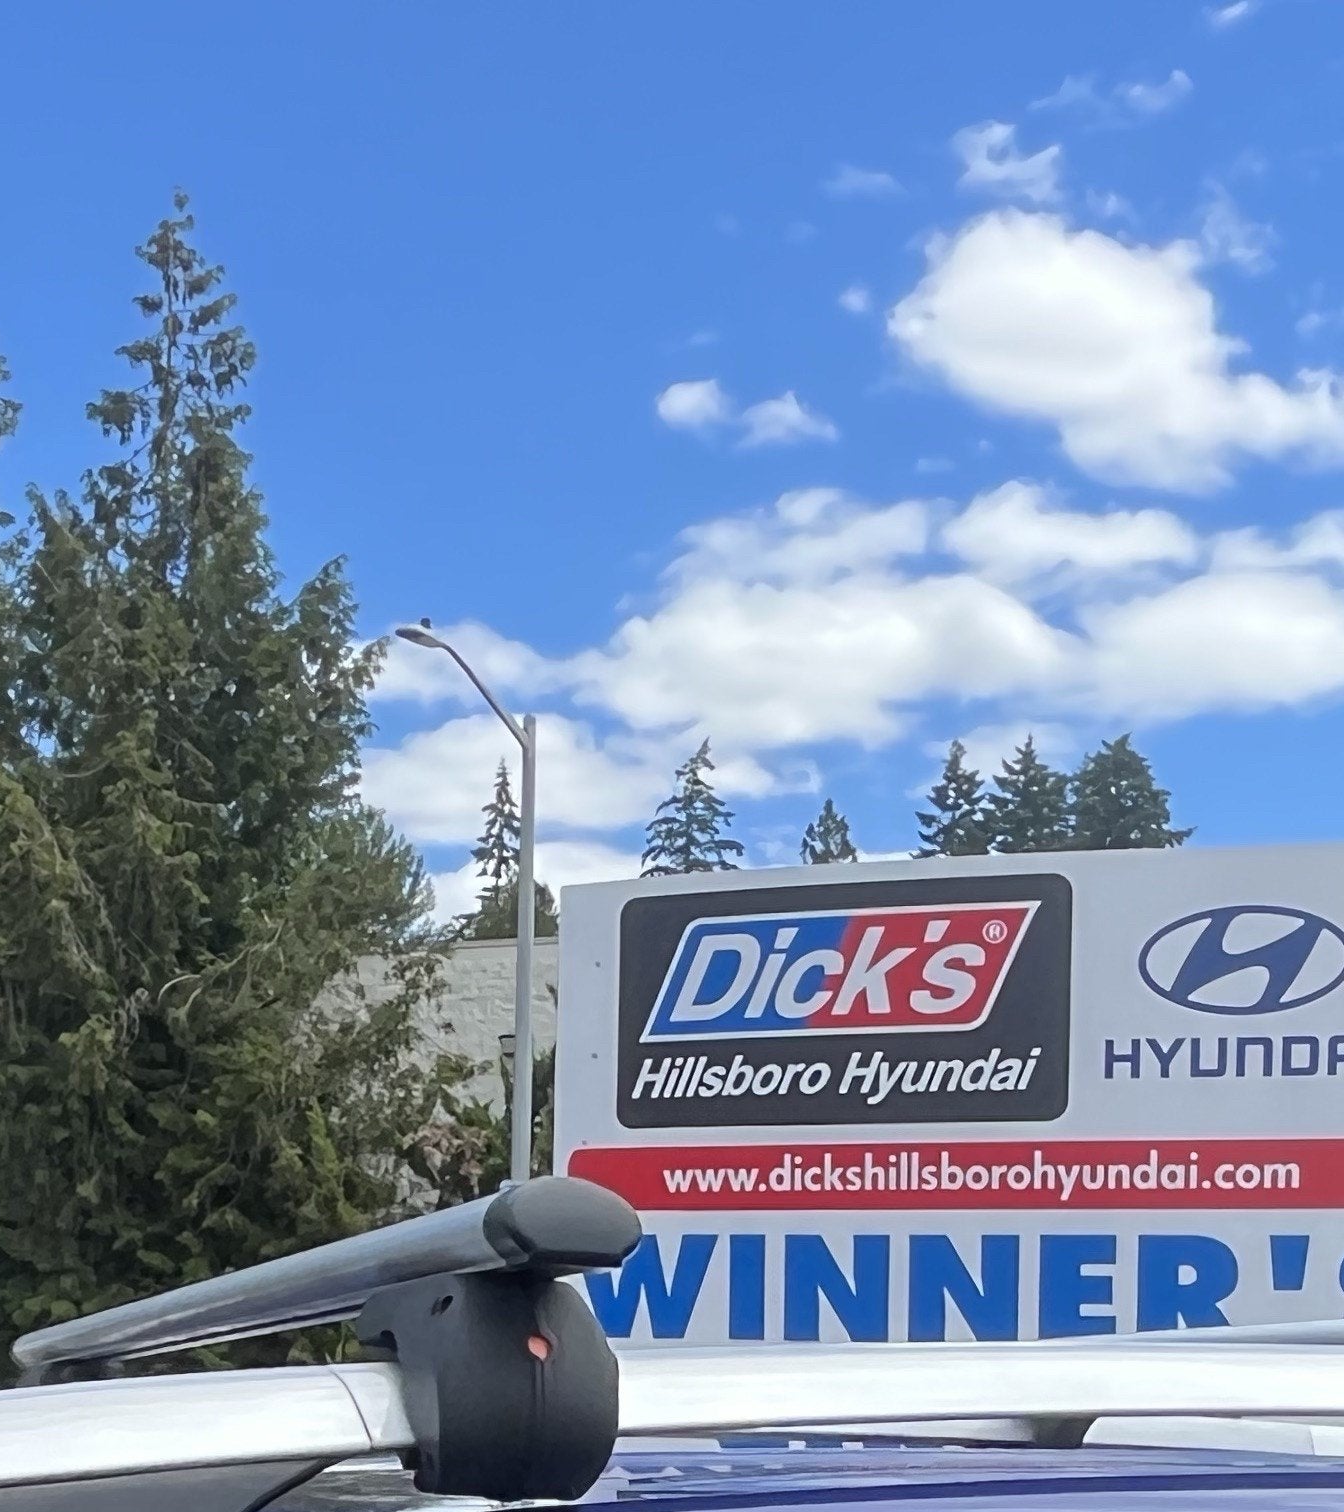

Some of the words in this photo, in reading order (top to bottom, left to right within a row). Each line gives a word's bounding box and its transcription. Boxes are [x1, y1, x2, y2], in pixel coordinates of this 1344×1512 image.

[631, 1054, 831, 1099] Hillsboro
[838, 1046, 1042, 1105] Hyundai
[663, 1149, 1301, 1203] www.dickshillsborohyundai.com
